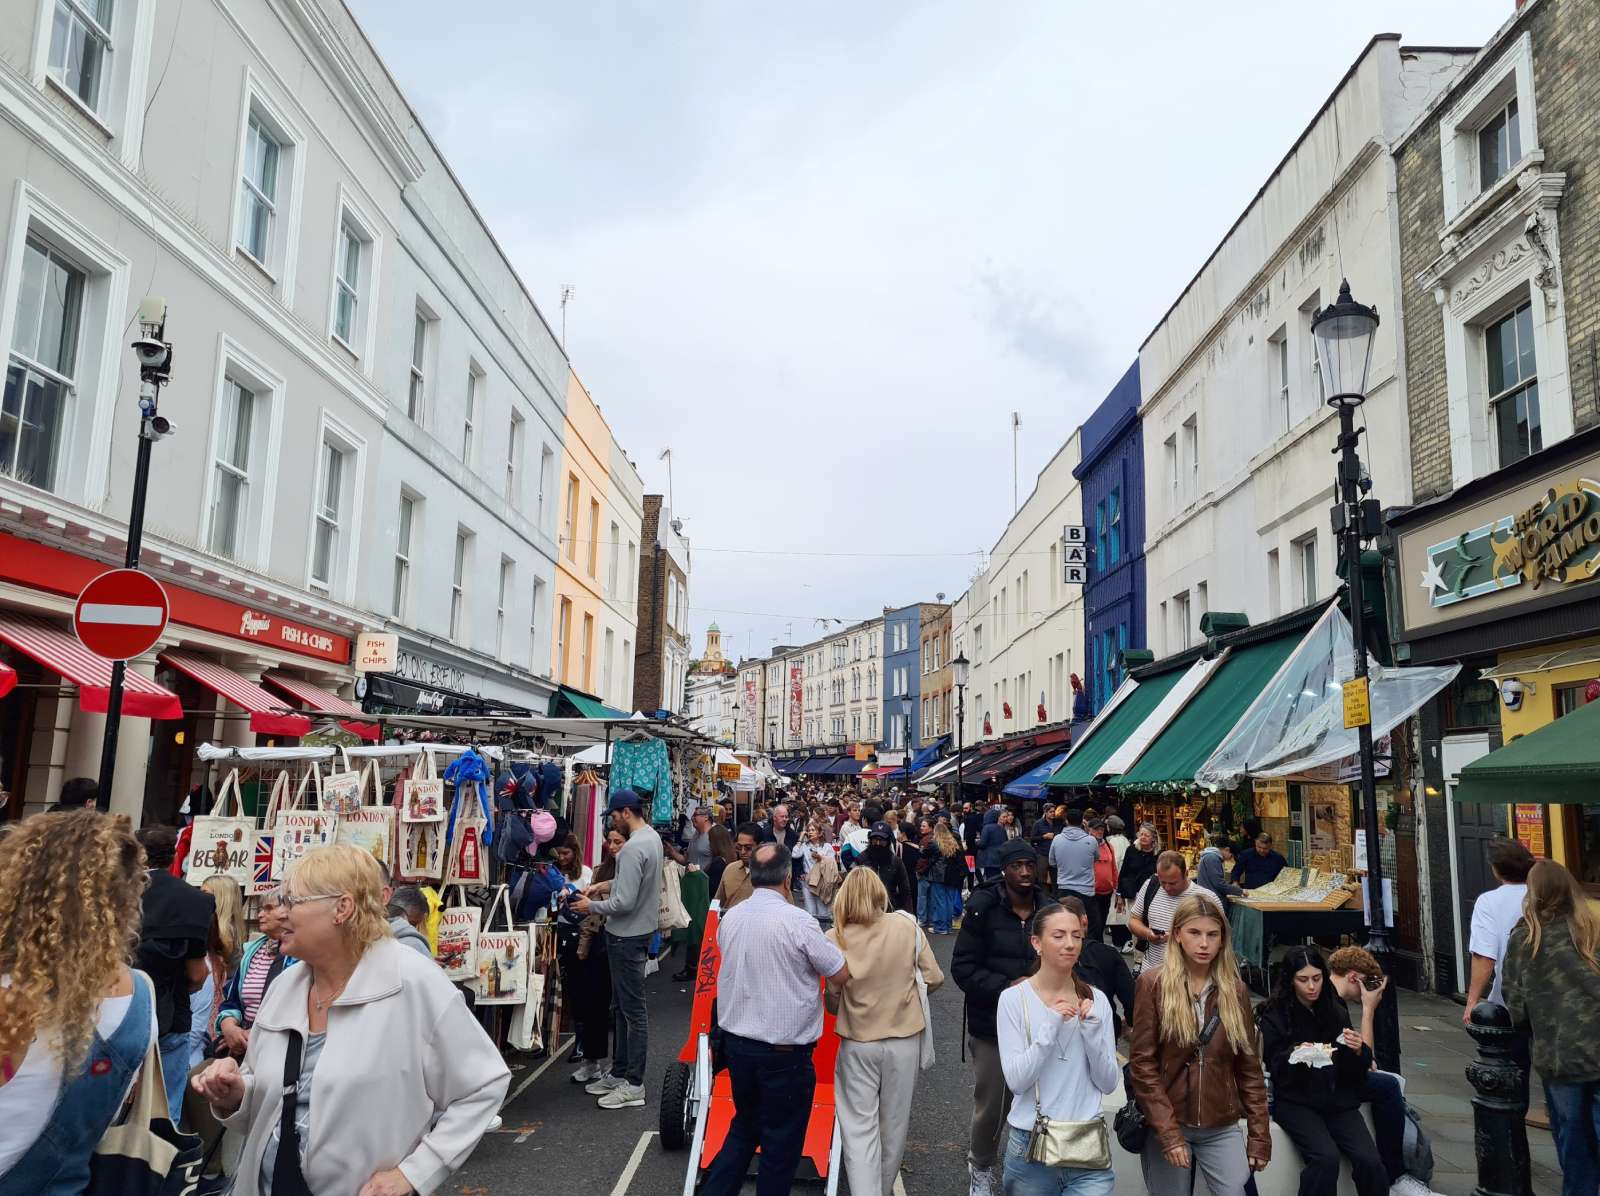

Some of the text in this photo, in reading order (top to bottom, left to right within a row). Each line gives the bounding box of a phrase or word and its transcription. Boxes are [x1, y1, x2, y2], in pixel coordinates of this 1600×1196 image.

[1513, 501, 1543, 537] THE
[1502, 493, 1589, 575] WORLD
[1069, 528, 1082, 581] BAR
[281, 625, 333, 653] FISH & CHIPS
[367, 640, 385, 648] FISH
[362, 656, 388, 665] CHIPS
[408, 784, 440, 794] LONDON
[285, 815, 328, 827] LONDON
[346, 811, 386, 823] LONDON
[209, 832, 234, 840] LONDO
[253, 883, 280, 892] LOND
[442, 912, 473, 925] NDON
[480, 937, 520, 950] ONDON
